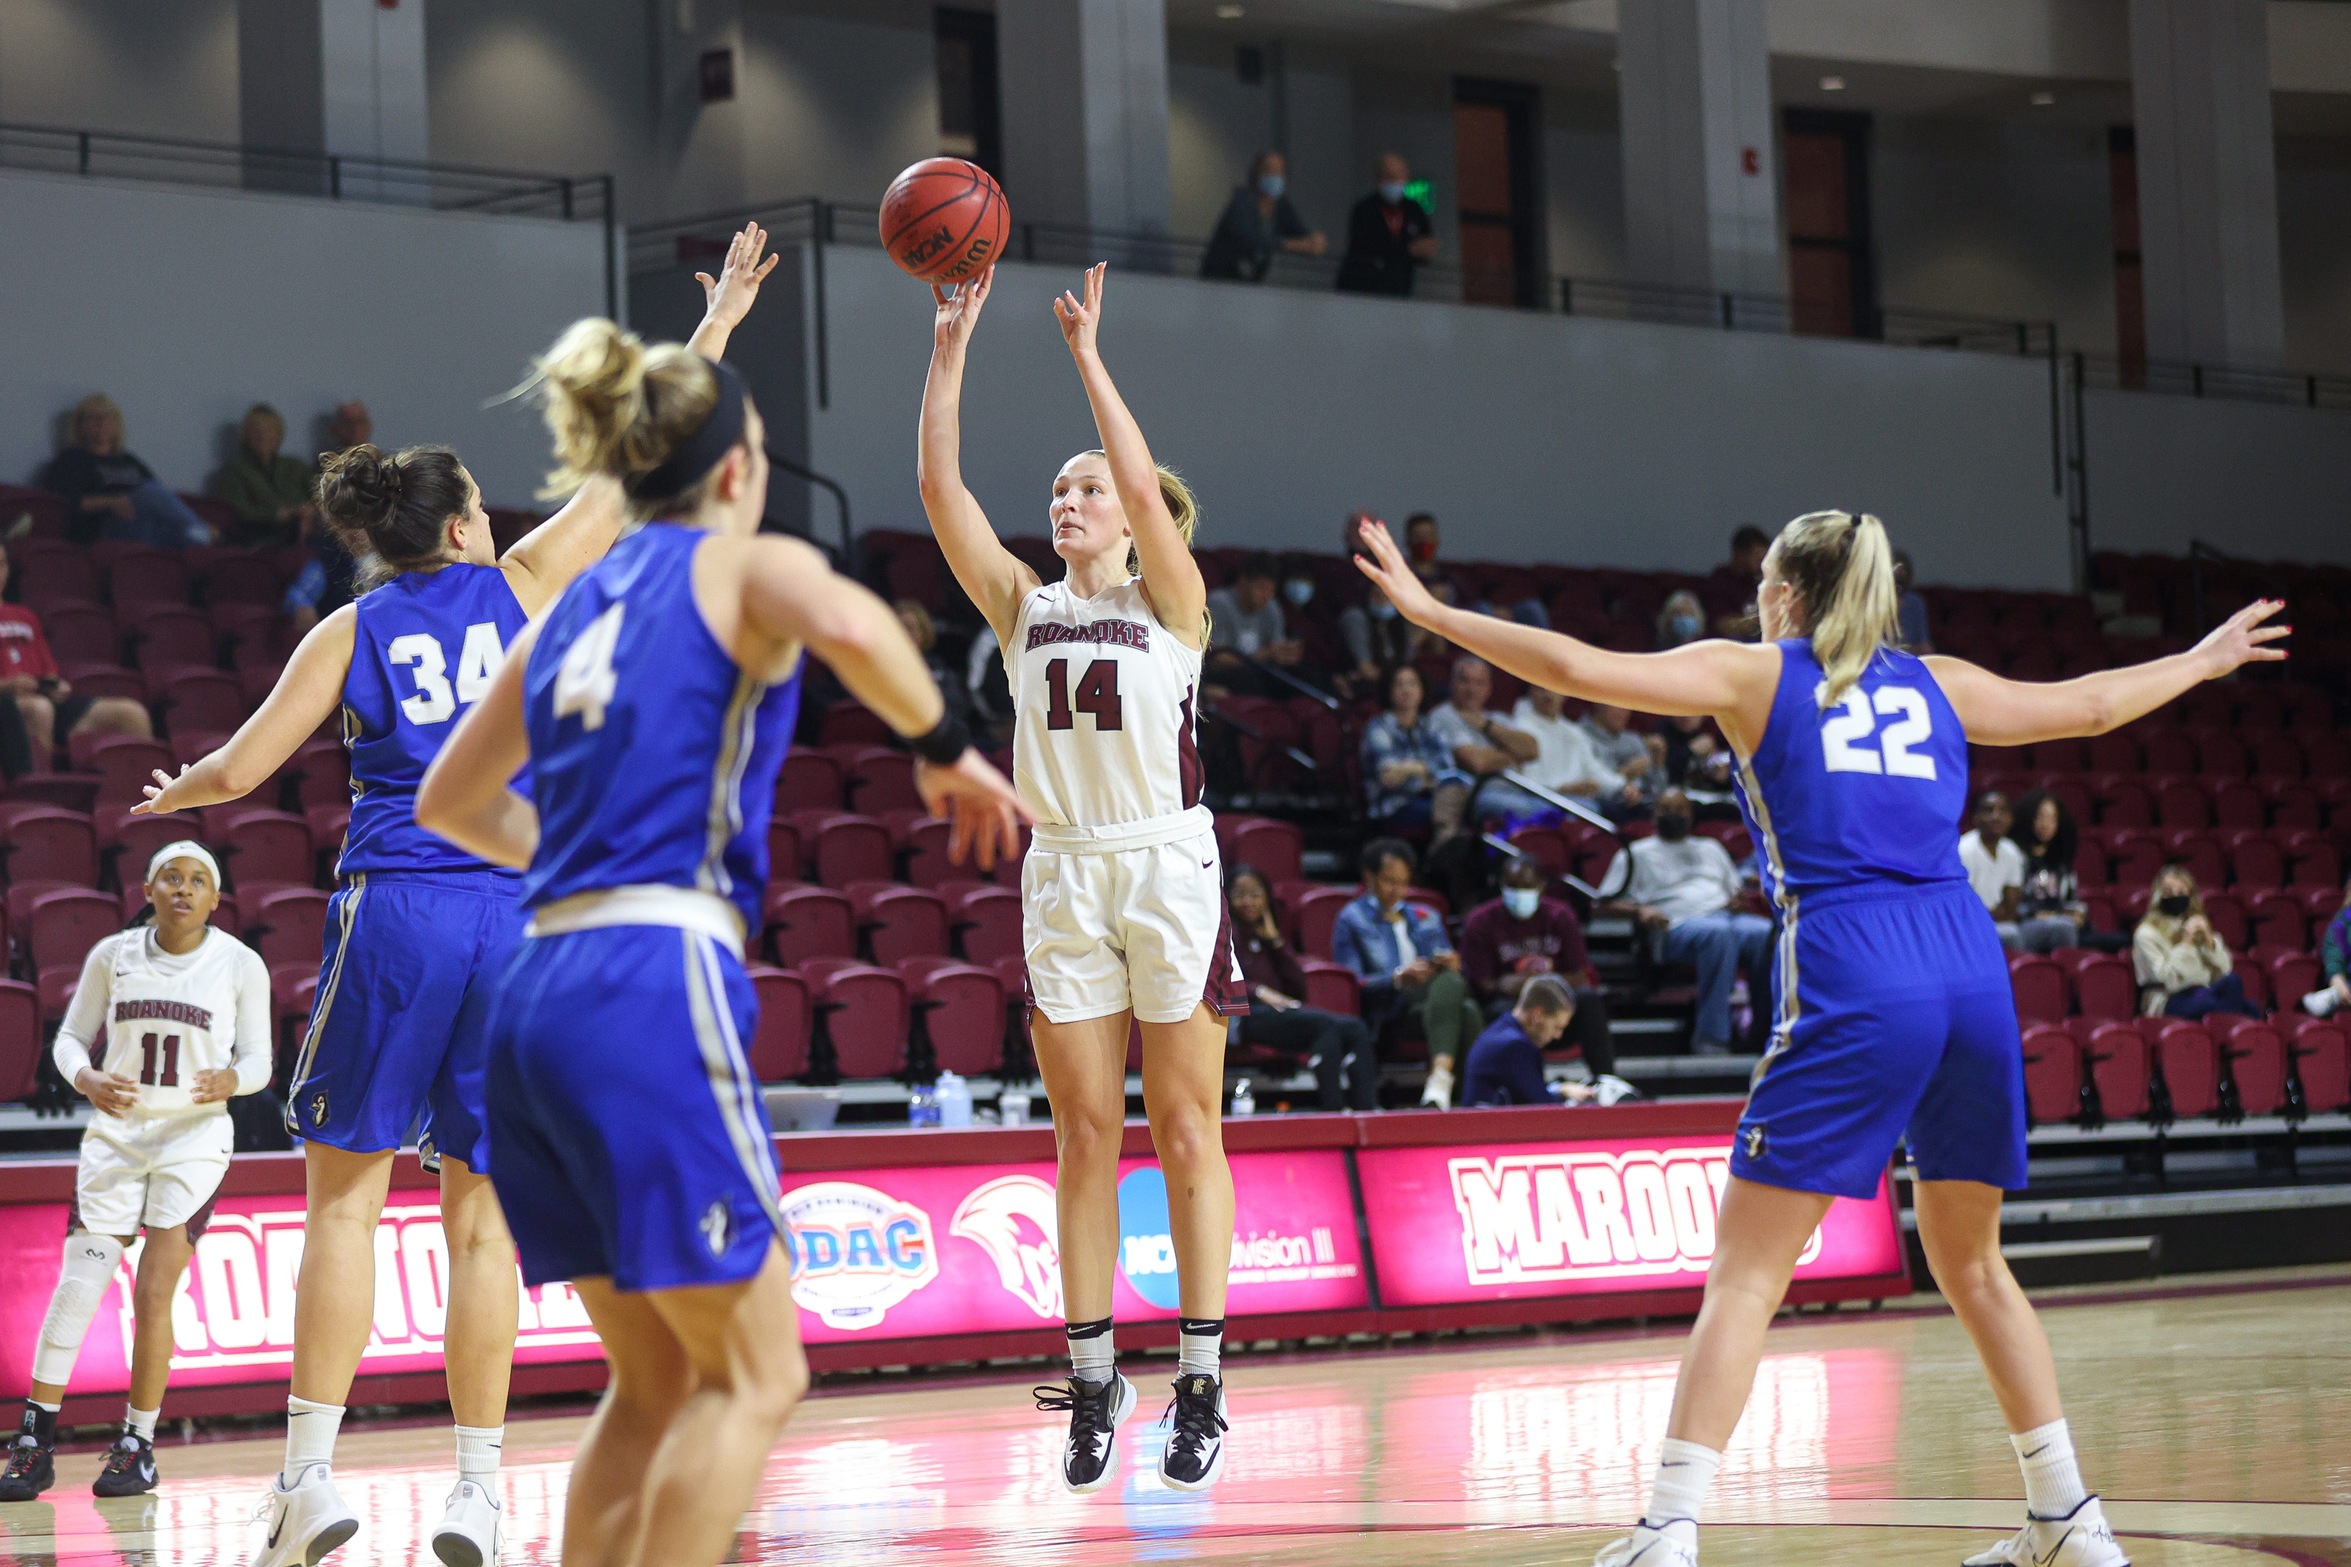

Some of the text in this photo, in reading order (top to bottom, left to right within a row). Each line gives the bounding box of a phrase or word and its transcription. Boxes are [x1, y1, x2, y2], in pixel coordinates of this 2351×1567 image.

[901, 226, 955, 269] NCAA
[930, 238, 992, 284] Wils
[1025, 618, 1150, 653] ROANOKE
[387, 621, 507, 726] 34
[552, 600, 627, 733] 4
[1045, 658, 1123, 731] 14
[1814, 680, 1937, 781] 22
[115, 999, 213, 1031] ROANOKE
[140, 1032, 181, 1087] 11
[1449, 1148, 1822, 1284] MAROO
[1229, 1230, 1313, 1268] ivision
